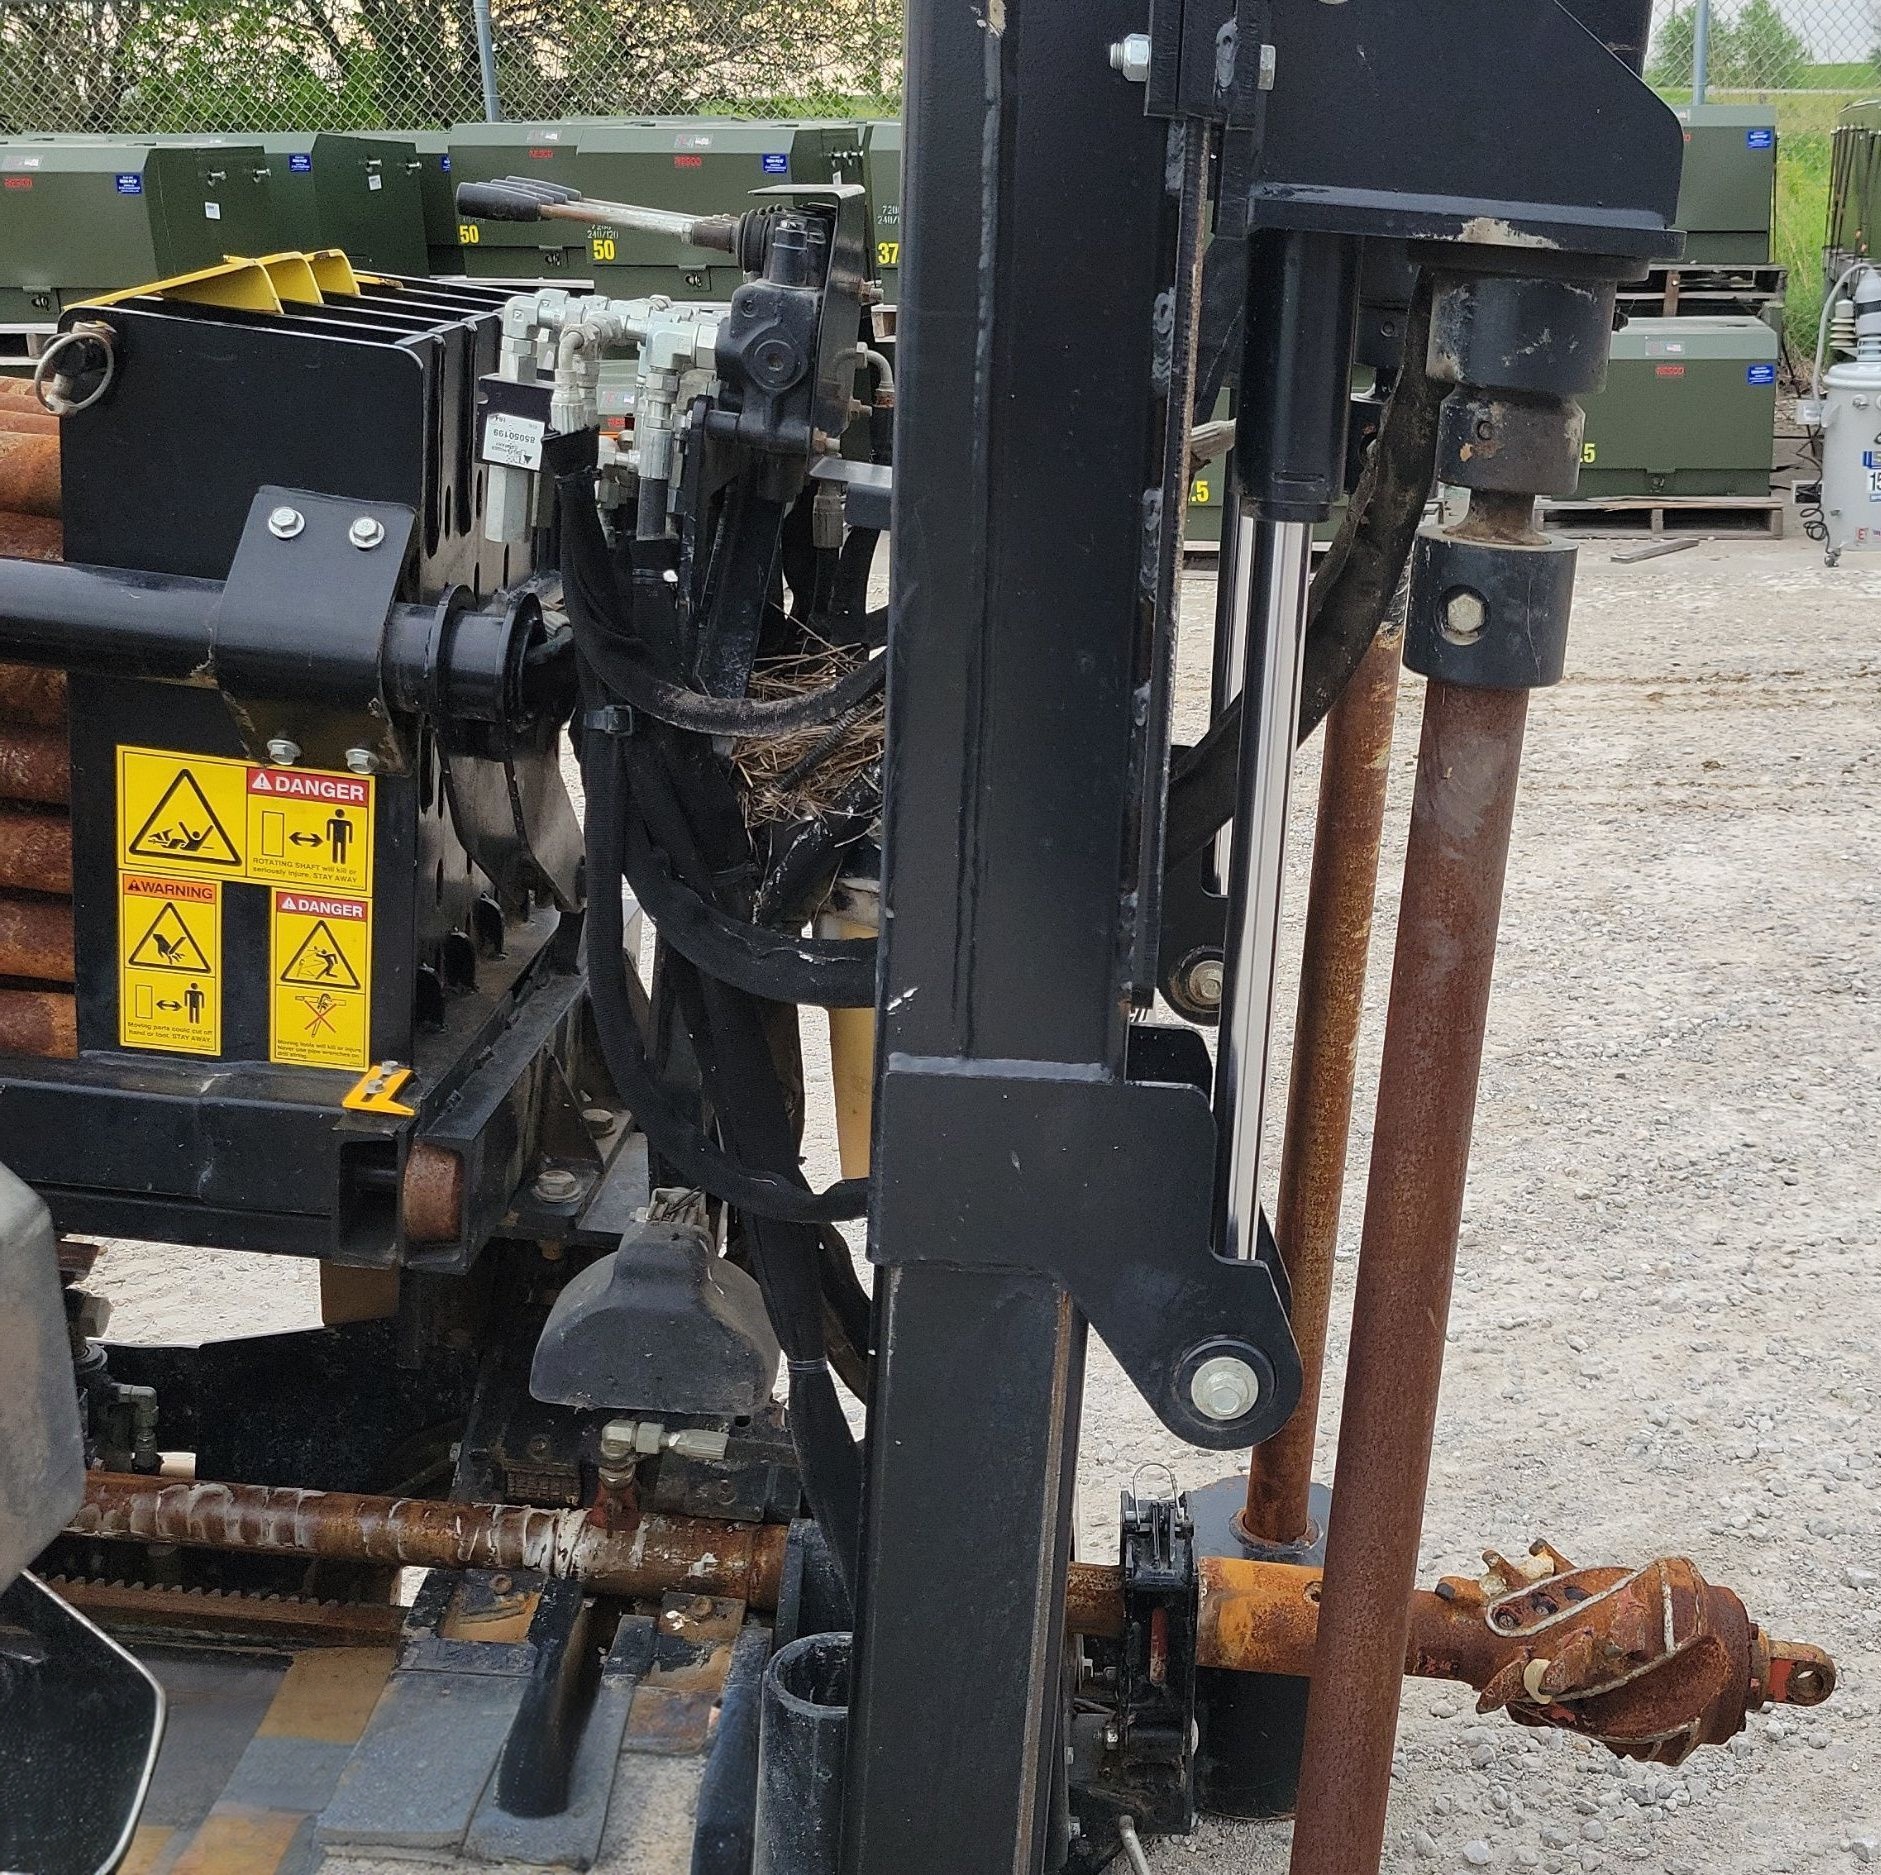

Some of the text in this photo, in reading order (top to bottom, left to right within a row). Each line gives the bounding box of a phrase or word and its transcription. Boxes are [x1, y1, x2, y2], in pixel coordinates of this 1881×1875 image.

[459, 224, 479, 243] 50
[593, 239, 615, 260] 50
[878, 242, 899, 264] 37
[275, 775, 365, 802] DANGER
[253, 857, 293, 868] ROTATING
[295, 862, 319, 871] SHAFT
[253, 867, 286, 876] seriously
[312, 872, 333, 880] STAY
[141, 881, 214, 900] WARNING
[297, 898, 364, 918] DANGER
